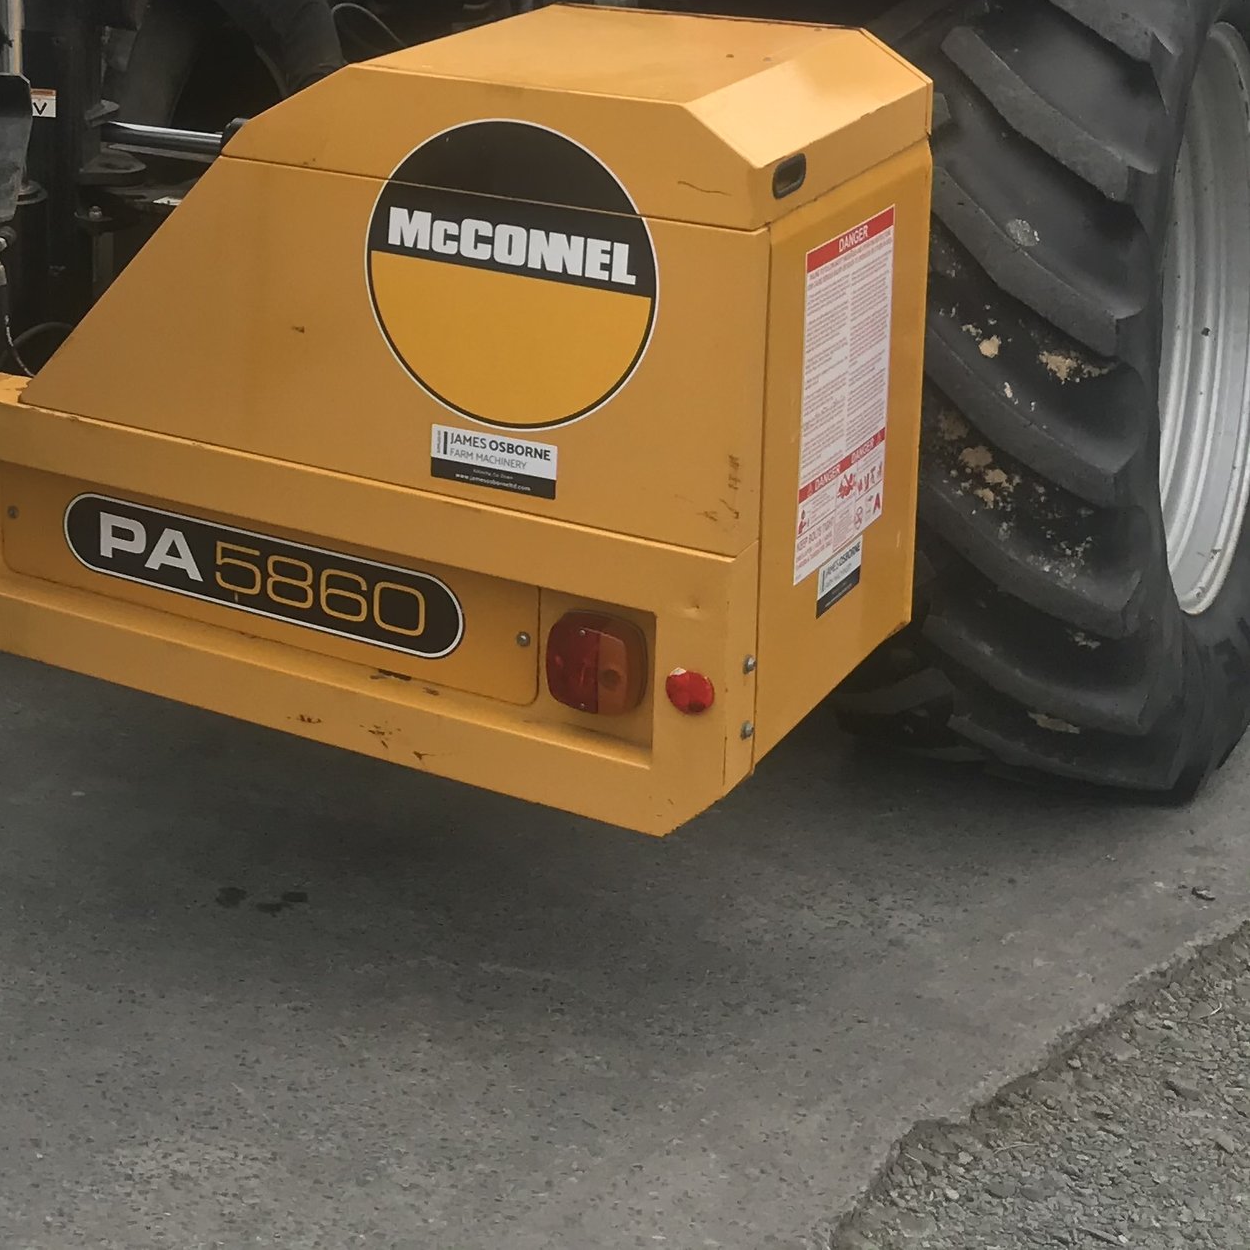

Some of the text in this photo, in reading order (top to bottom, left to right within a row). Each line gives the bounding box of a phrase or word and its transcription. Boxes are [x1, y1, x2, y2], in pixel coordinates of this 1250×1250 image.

[838, 224, 869, 253] DANGER
[449, 431, 487, 450] JAMES
[488, 439, 551, 461] OSBORNE
[449, 446, 527, 471] FARM MACHINERY
[99, 511, 426, 637] PA 5860
